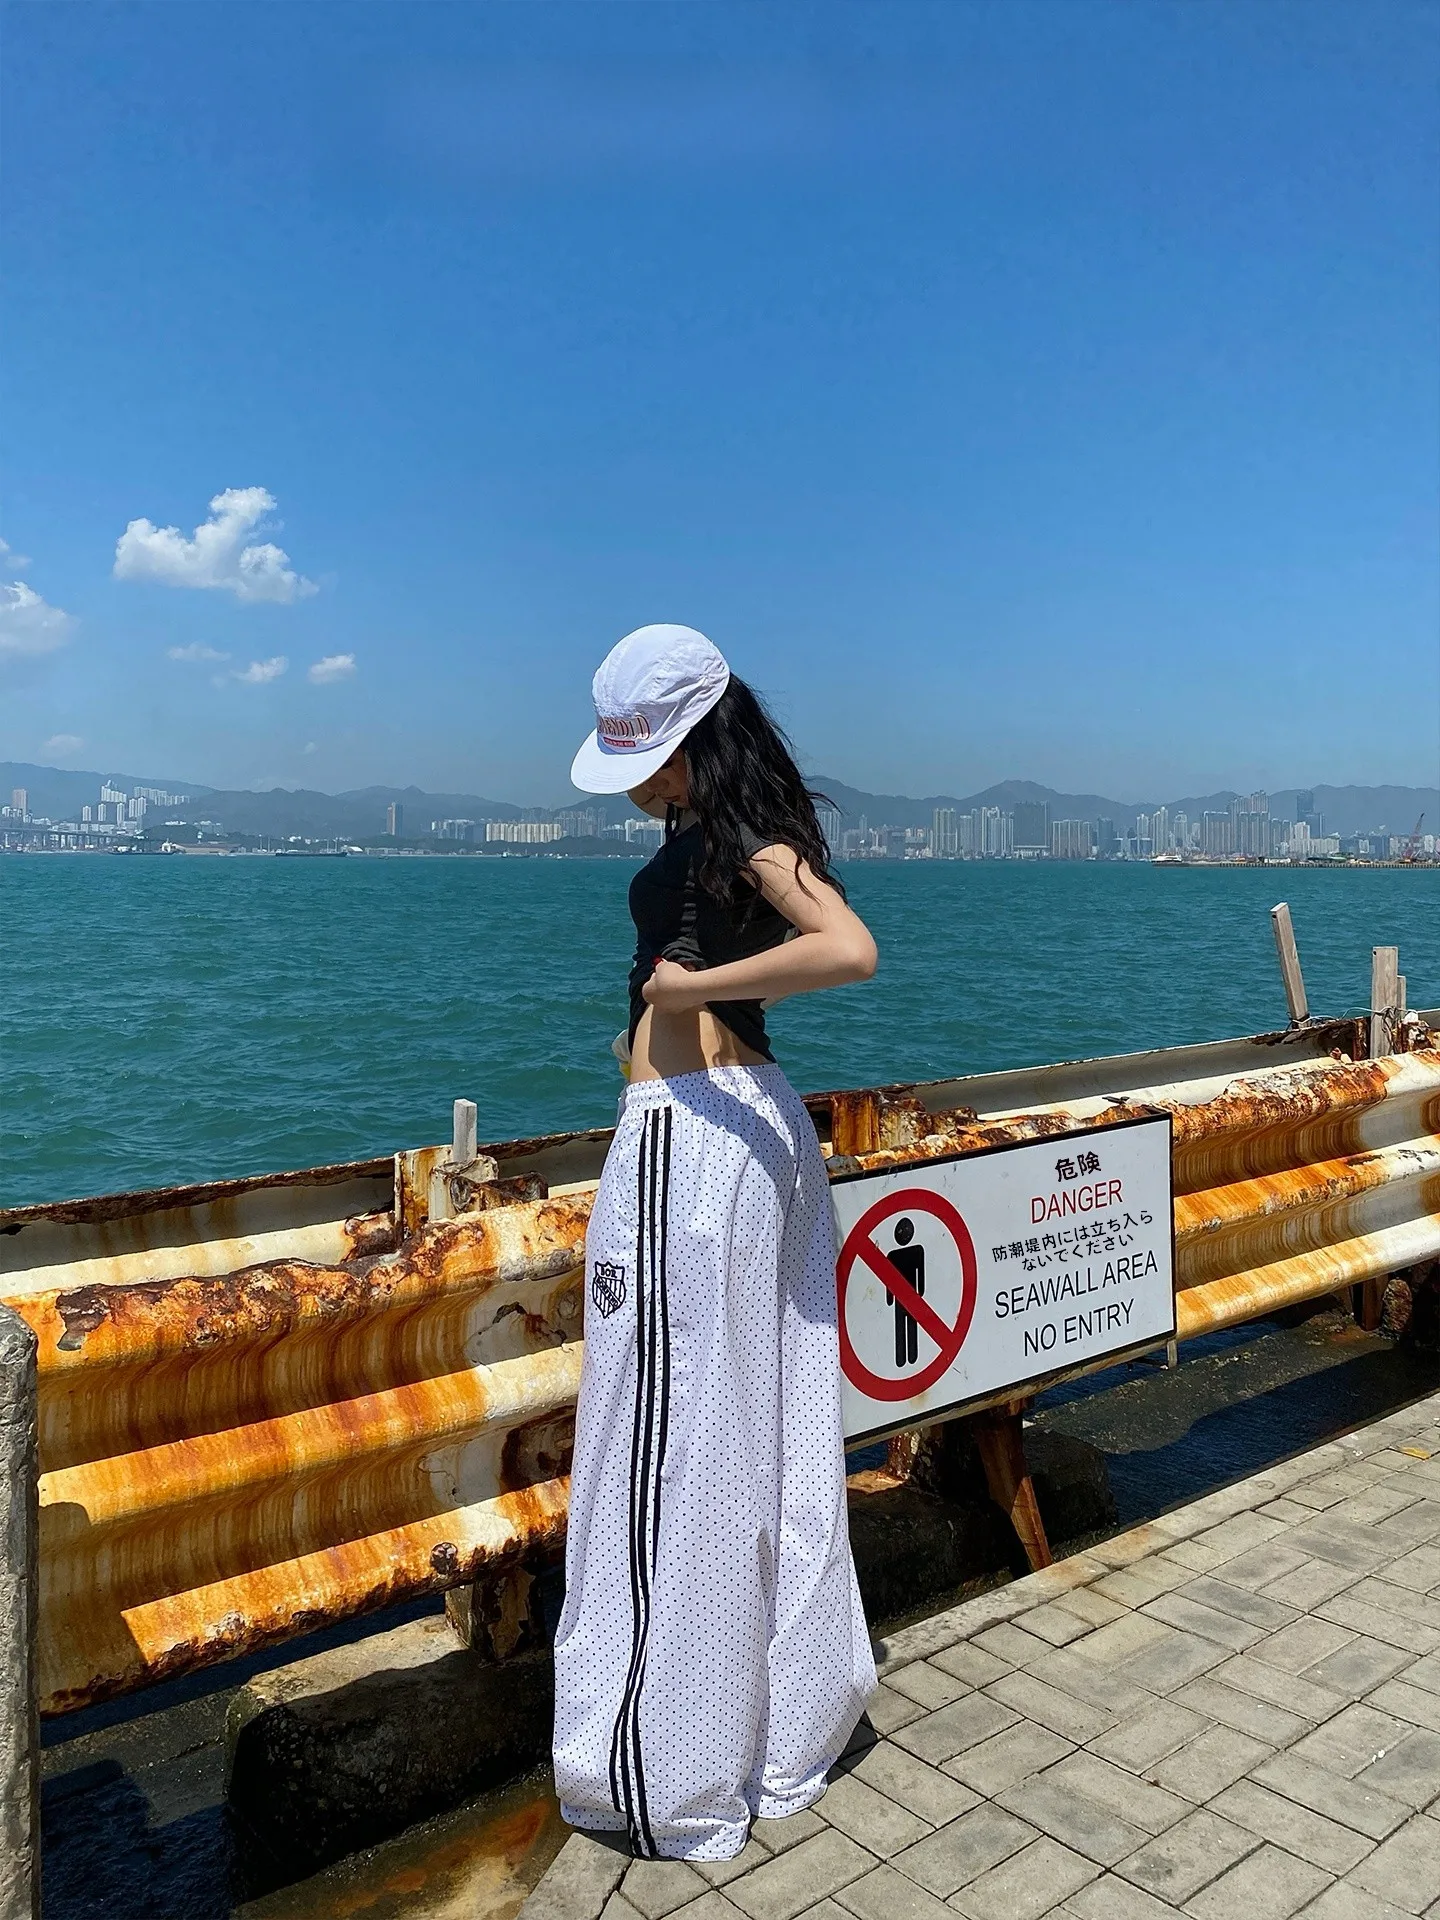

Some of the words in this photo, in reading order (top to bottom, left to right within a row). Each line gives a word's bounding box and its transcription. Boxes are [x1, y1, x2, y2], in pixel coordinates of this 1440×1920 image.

[1055, 1151, 1101, 1182] 危険
[1030, 1179, 1123, 1224] DANGER
[992, 1210, 1153, 1262] 防潮堤内には立ち入ら
[1022, 1234, 1134, 1271] ないでください
[995, 1267, 1098, 1318] SEAWALL
[1102, 1250, 1158, 1288] AREA
[1024, 1323, 1056, 1356] NO
[1064, 1299, 1134, 1343] ENTRY
